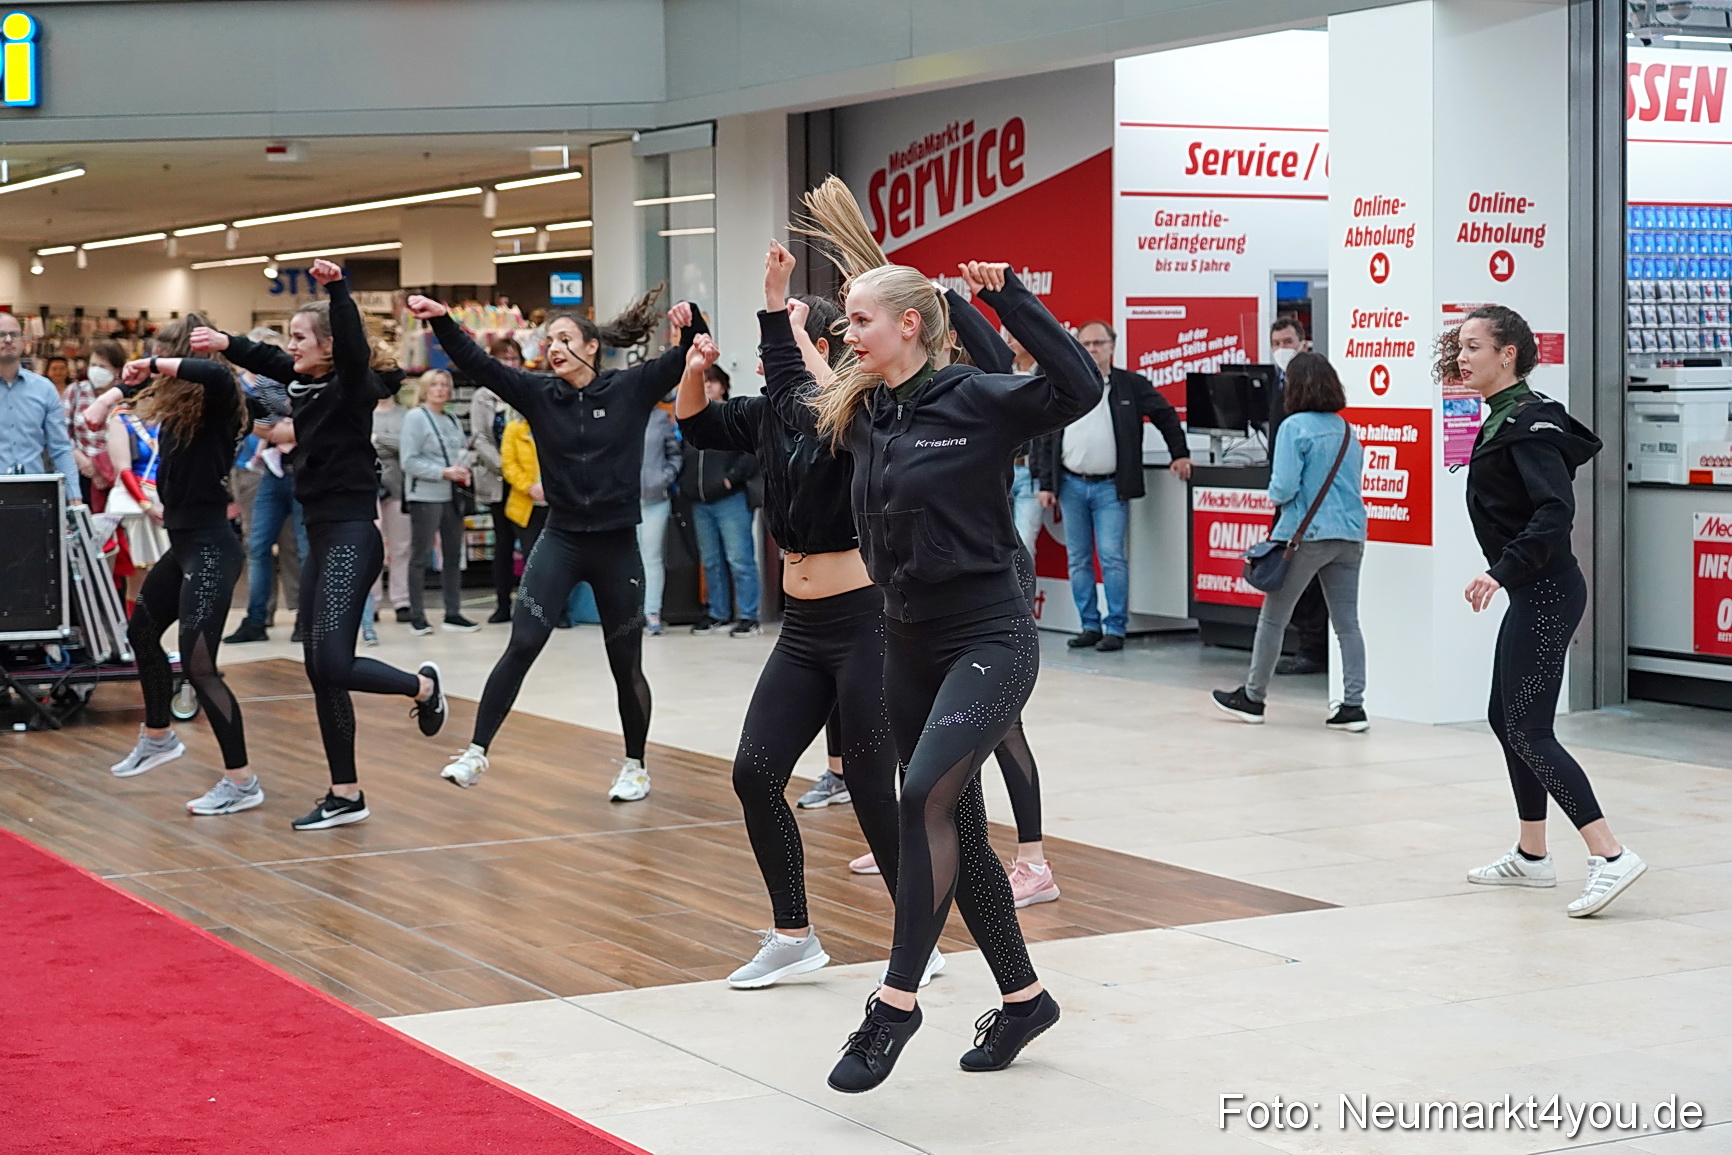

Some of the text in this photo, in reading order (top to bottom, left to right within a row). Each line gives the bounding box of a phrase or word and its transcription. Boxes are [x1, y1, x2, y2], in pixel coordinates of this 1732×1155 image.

[0, 11, 36, 106] i
[1627, 62, 1728, 124] SSEN
[889, 119, 960, 174] MediaMarkt
[1185, 141, 1298, 178] Service
[868, 116, 1025, 246] Service
[1353, 195, 1407, 217] Online-
[1468, 192, 1535, 214] Online-
[1155, 210, 1230, 228] Garantie-
[1138, 232, 1247, 255] verlängerung
[1344, 223, 1416, 248] Abholung
[1456, 222, 1547, 249] Abholung
[1155, 259, 1231, 274] bis zu 5 Jahre
[1351, 307, 1410, 329] Service-
[1139, 347, 1182, 367] sicheren
[1183, 340, 1207, 357] Seite
[1345, 337, 1415, 359] Annahme
[914, 437, 967, 448] Kristina
[1367, 424, 1402, 441] halten
[1402, 425, 1418, 443] Sie
[1368, 450, 1390, 470] 2m
[1362, 474, 1405, 492] bstand
[1364, 502, 1411, 521] inander.
[1209, 521, 1269, 550] ONLINE
